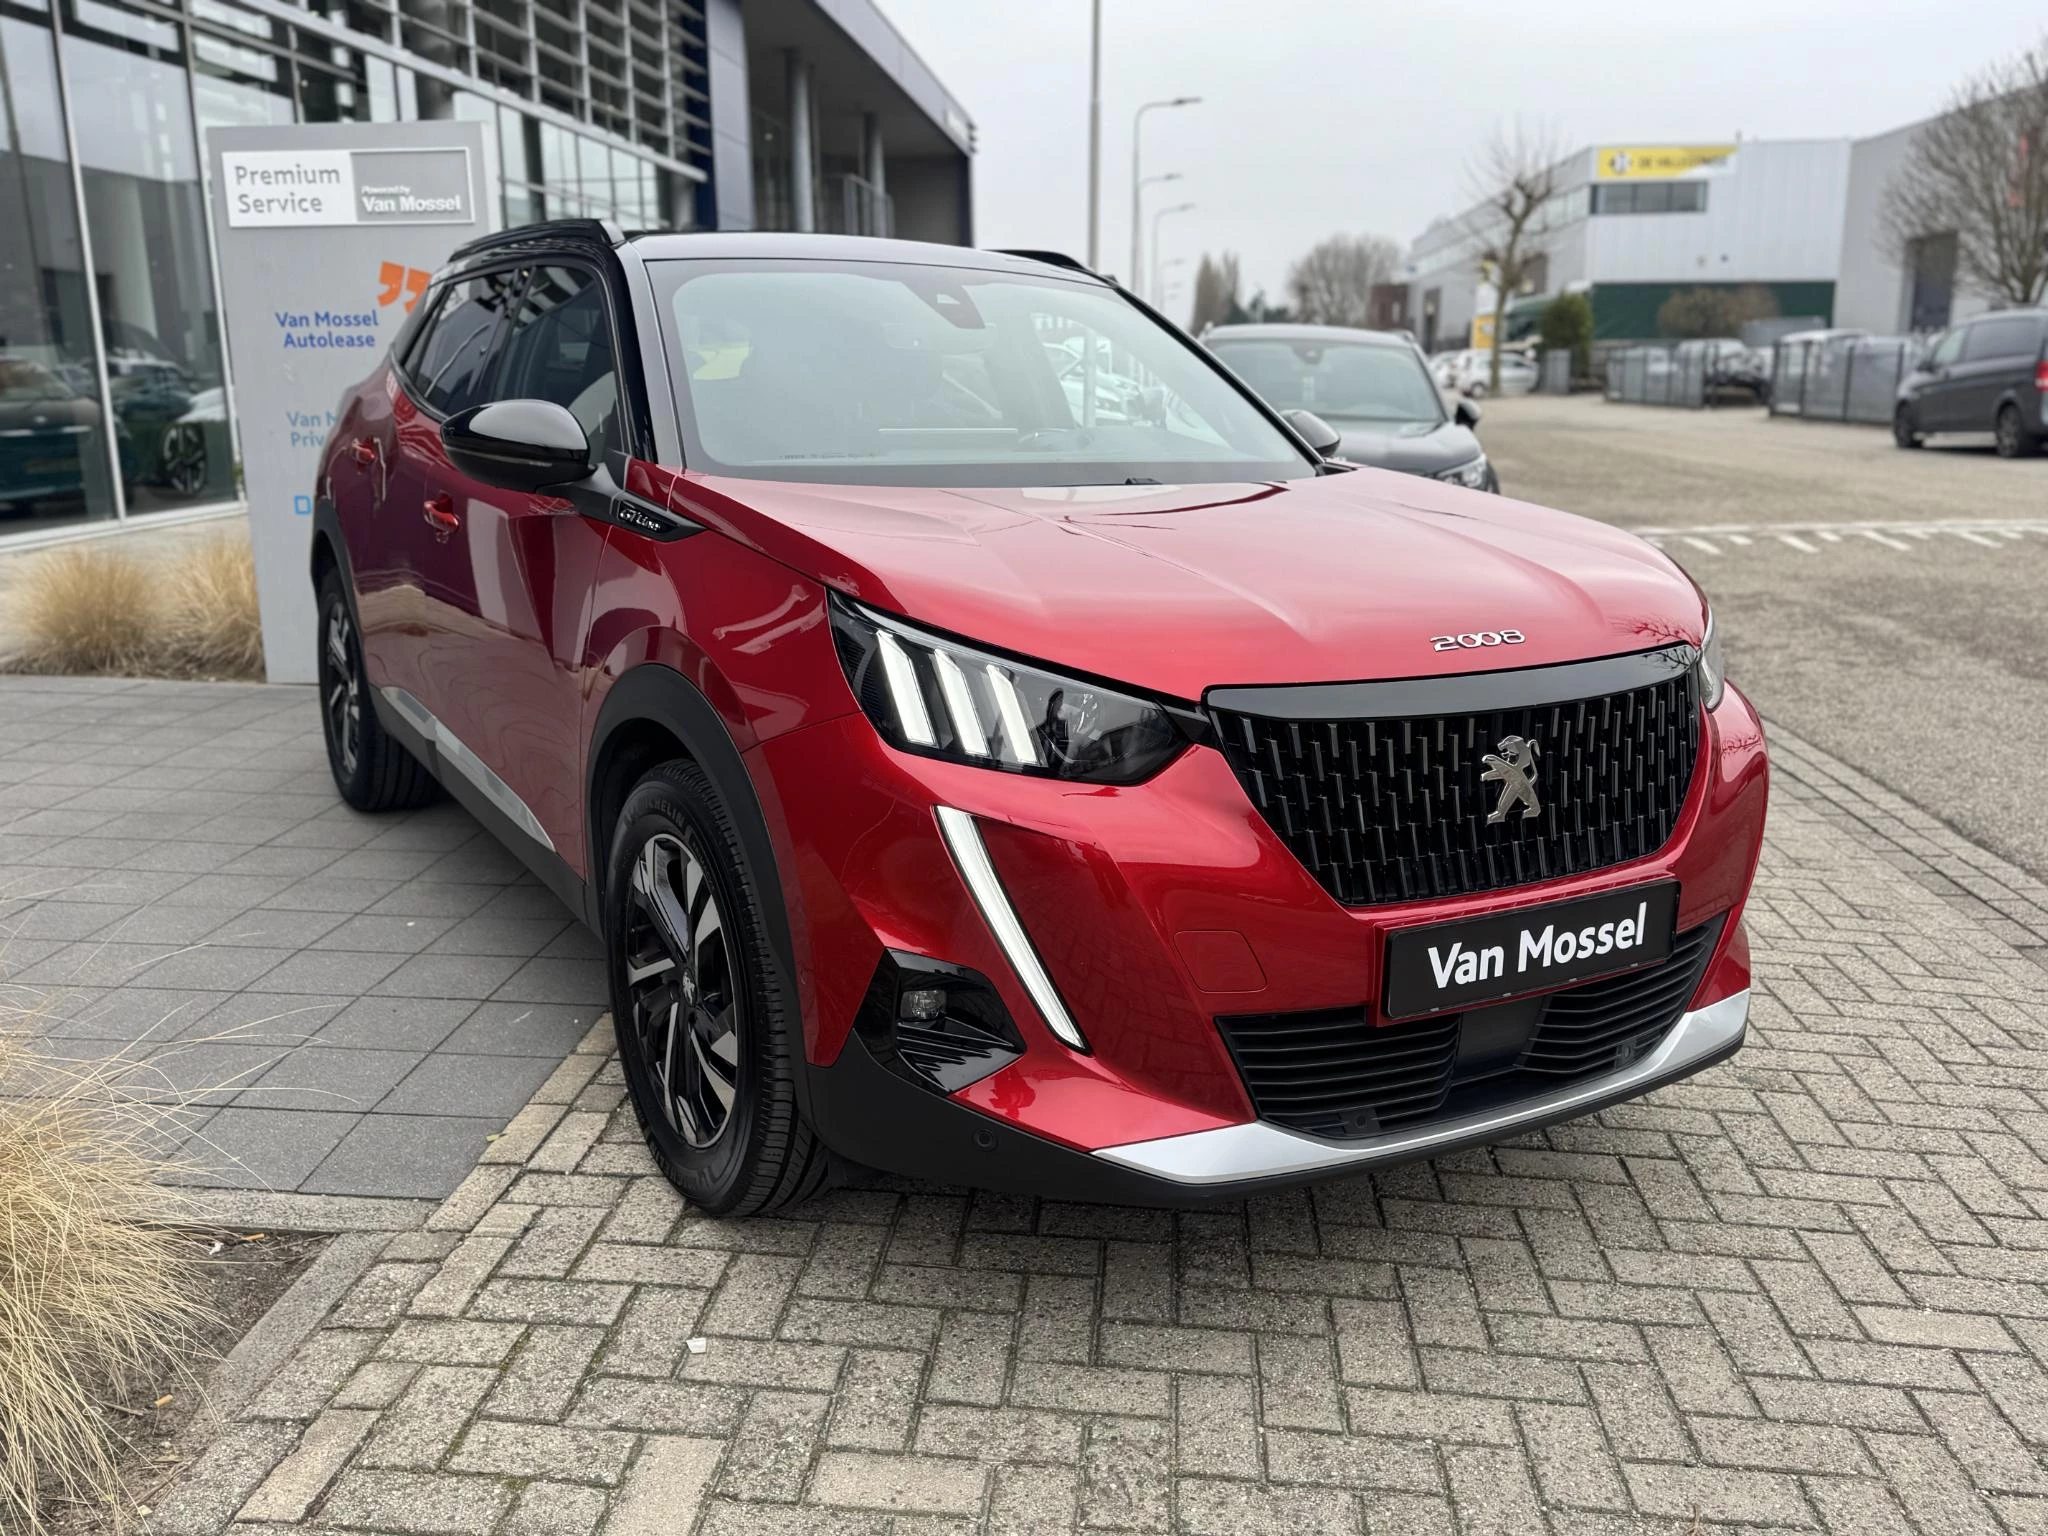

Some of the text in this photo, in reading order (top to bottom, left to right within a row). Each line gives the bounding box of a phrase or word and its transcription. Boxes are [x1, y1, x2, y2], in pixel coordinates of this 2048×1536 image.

[235, 164, 340, 186] Premium
[238, 193, 323, 214] Service
[361, 194, 461, 213] Van Mossel
[275, 310, 378, 328] Van Mossel
[283, 331, 376, 348] Autolease
[287, 412, 320, 426] Van
[290, 432, 324, 446] Priv
[1430, 629, 1525, 651] 2008
[1428, 902, 1647, 989] Van Mossel
